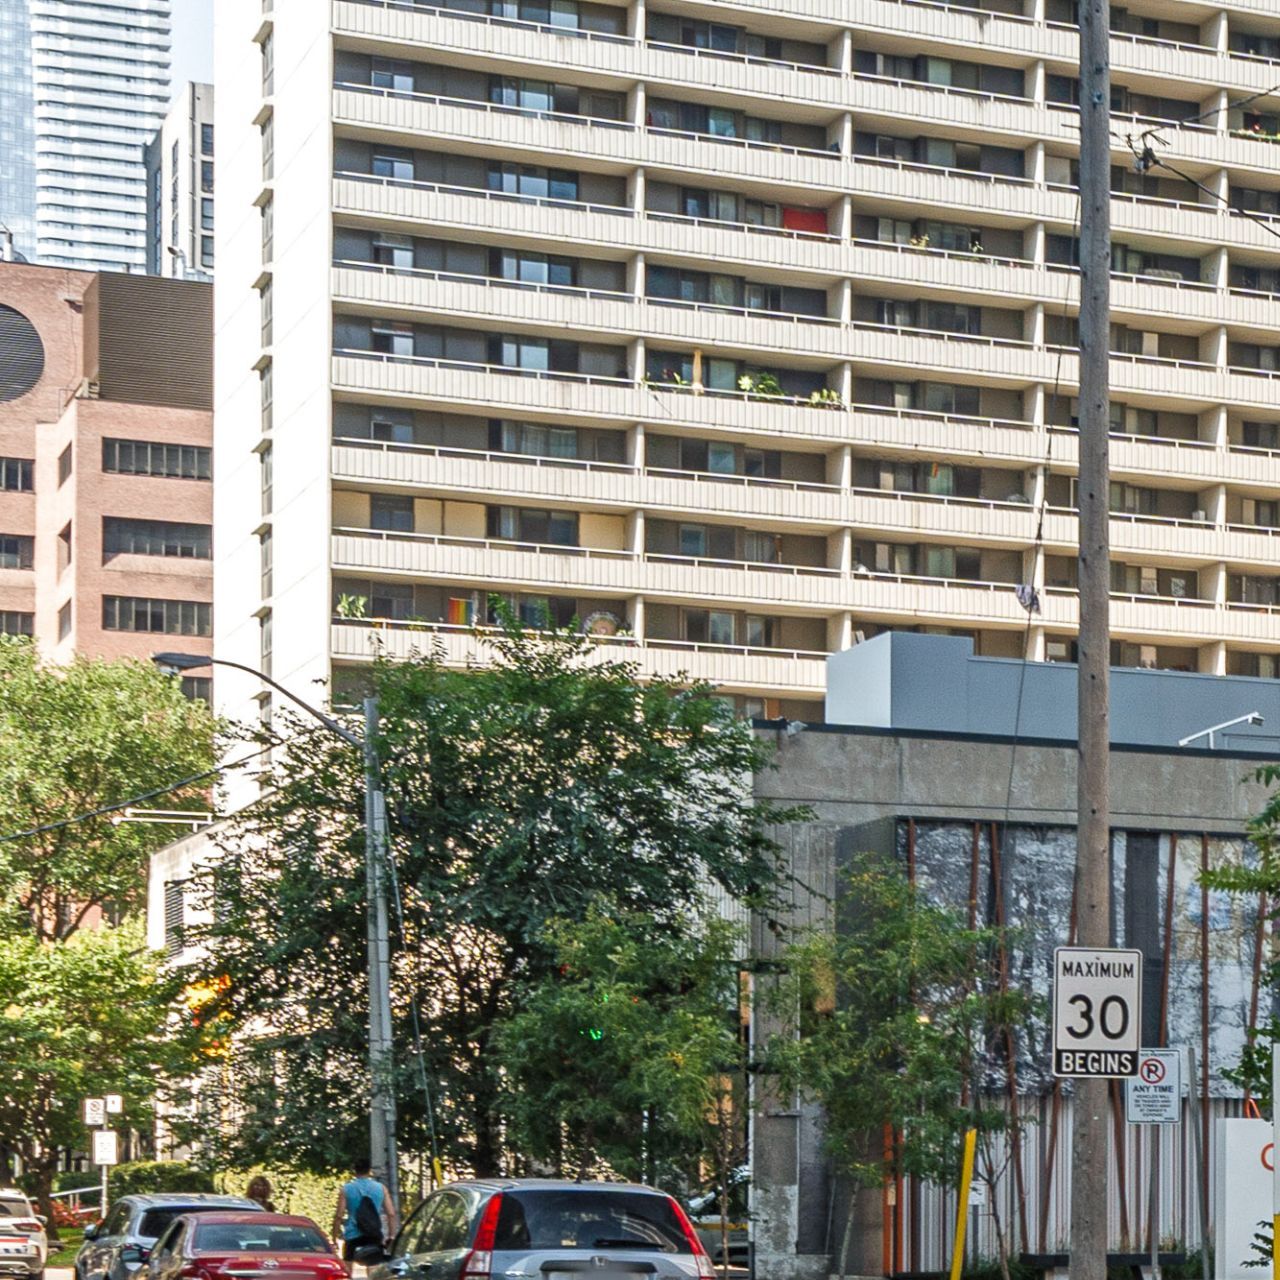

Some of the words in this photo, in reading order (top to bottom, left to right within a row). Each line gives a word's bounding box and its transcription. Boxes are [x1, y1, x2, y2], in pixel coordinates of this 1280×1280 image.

[1062, 961, 1134, 978] MAXIMUM
[1065, 994, 1129, 1040] 30
[1062, 1052, 1132, 1074] BEGINS
